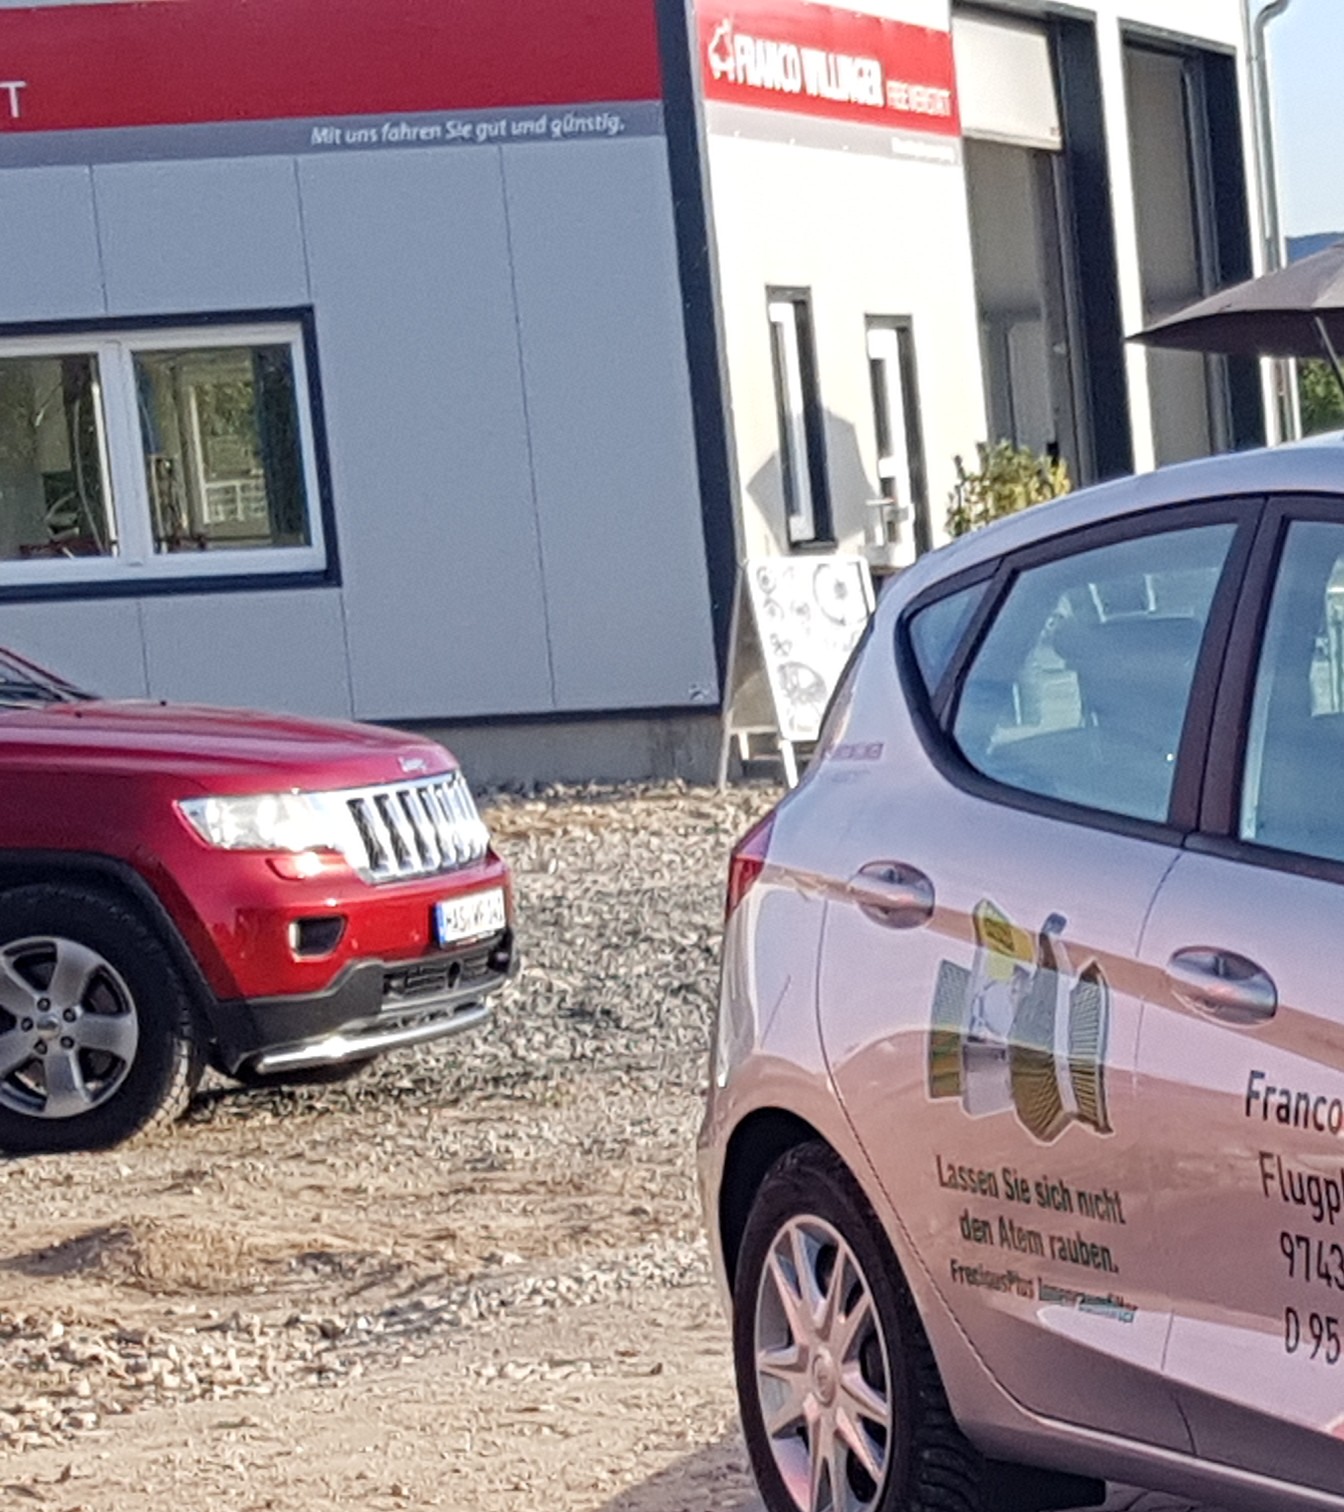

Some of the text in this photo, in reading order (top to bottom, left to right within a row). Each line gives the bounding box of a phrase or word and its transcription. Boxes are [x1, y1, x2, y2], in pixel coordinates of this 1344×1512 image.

[310, 111, 626, 145] Mit uns fahren Sie gut und günstig.
[1244, 1069, 1344, 1135] Franco
[936, 1154, 1127, 1225] Lassen Sie sich nicht
[958, 1207, 1120, 1275] den Atem rauben.
[1308, 1312, 1341, 1365] 95
